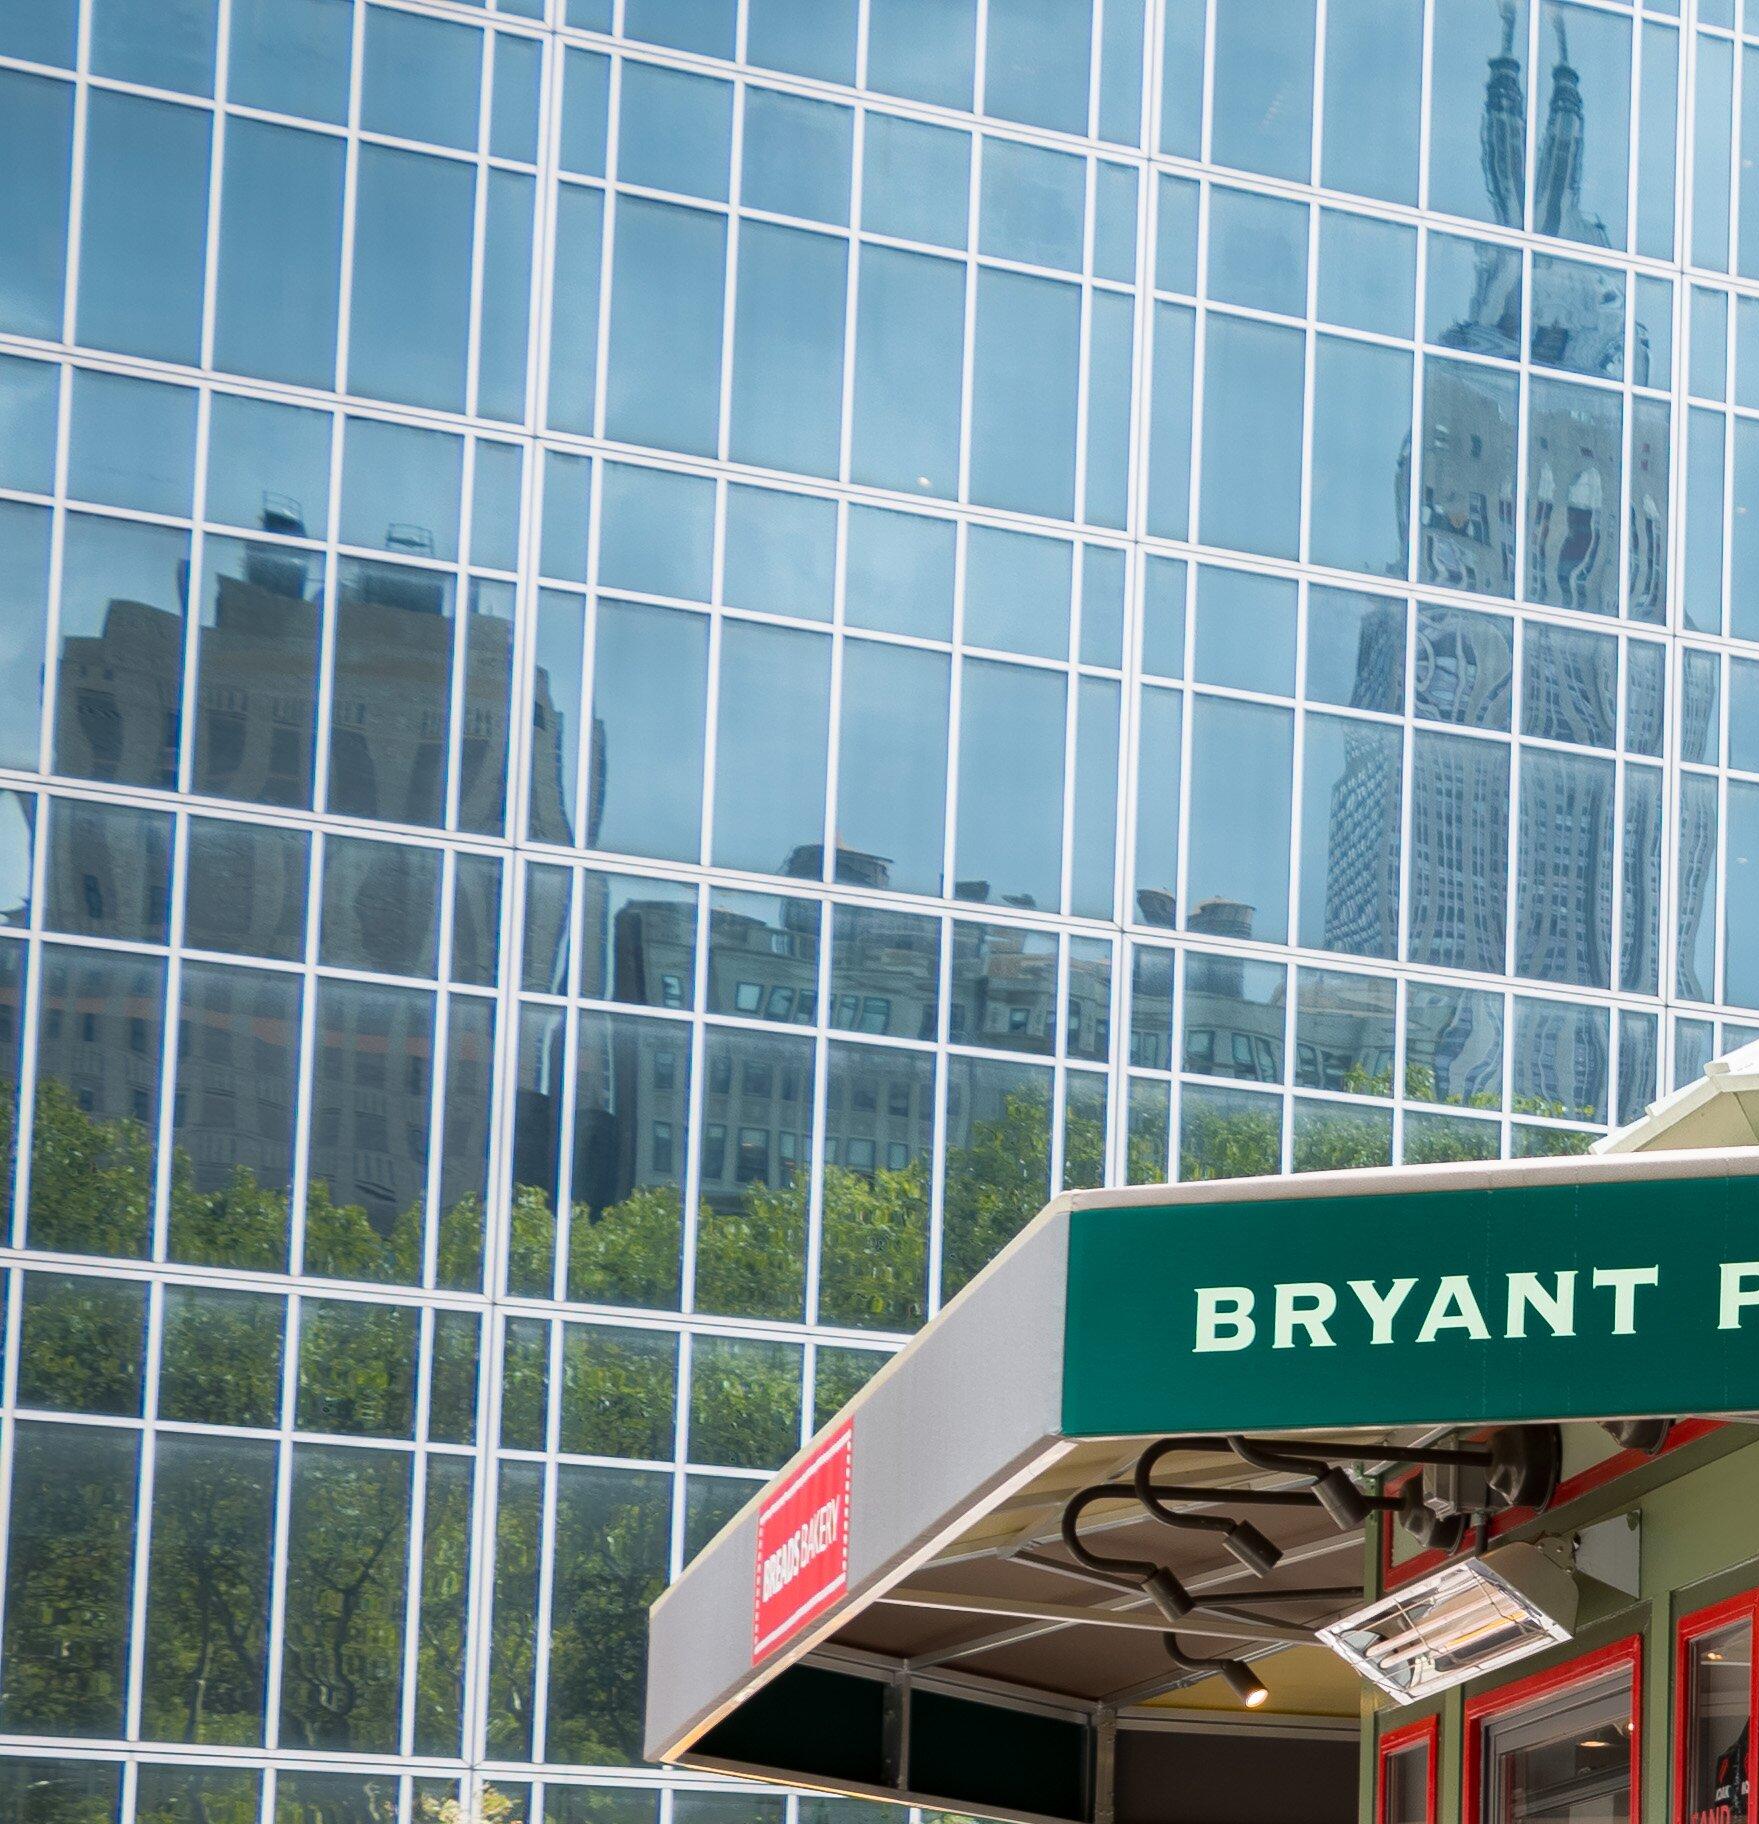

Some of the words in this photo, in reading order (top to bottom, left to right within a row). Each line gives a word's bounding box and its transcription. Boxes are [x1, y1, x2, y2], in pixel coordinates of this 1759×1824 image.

[1192, 1263, 1659, 1352] BRYANT
[763, 1529, 800, 1603] BREADS
[800, 1494, 841, 1567] BAKERY
